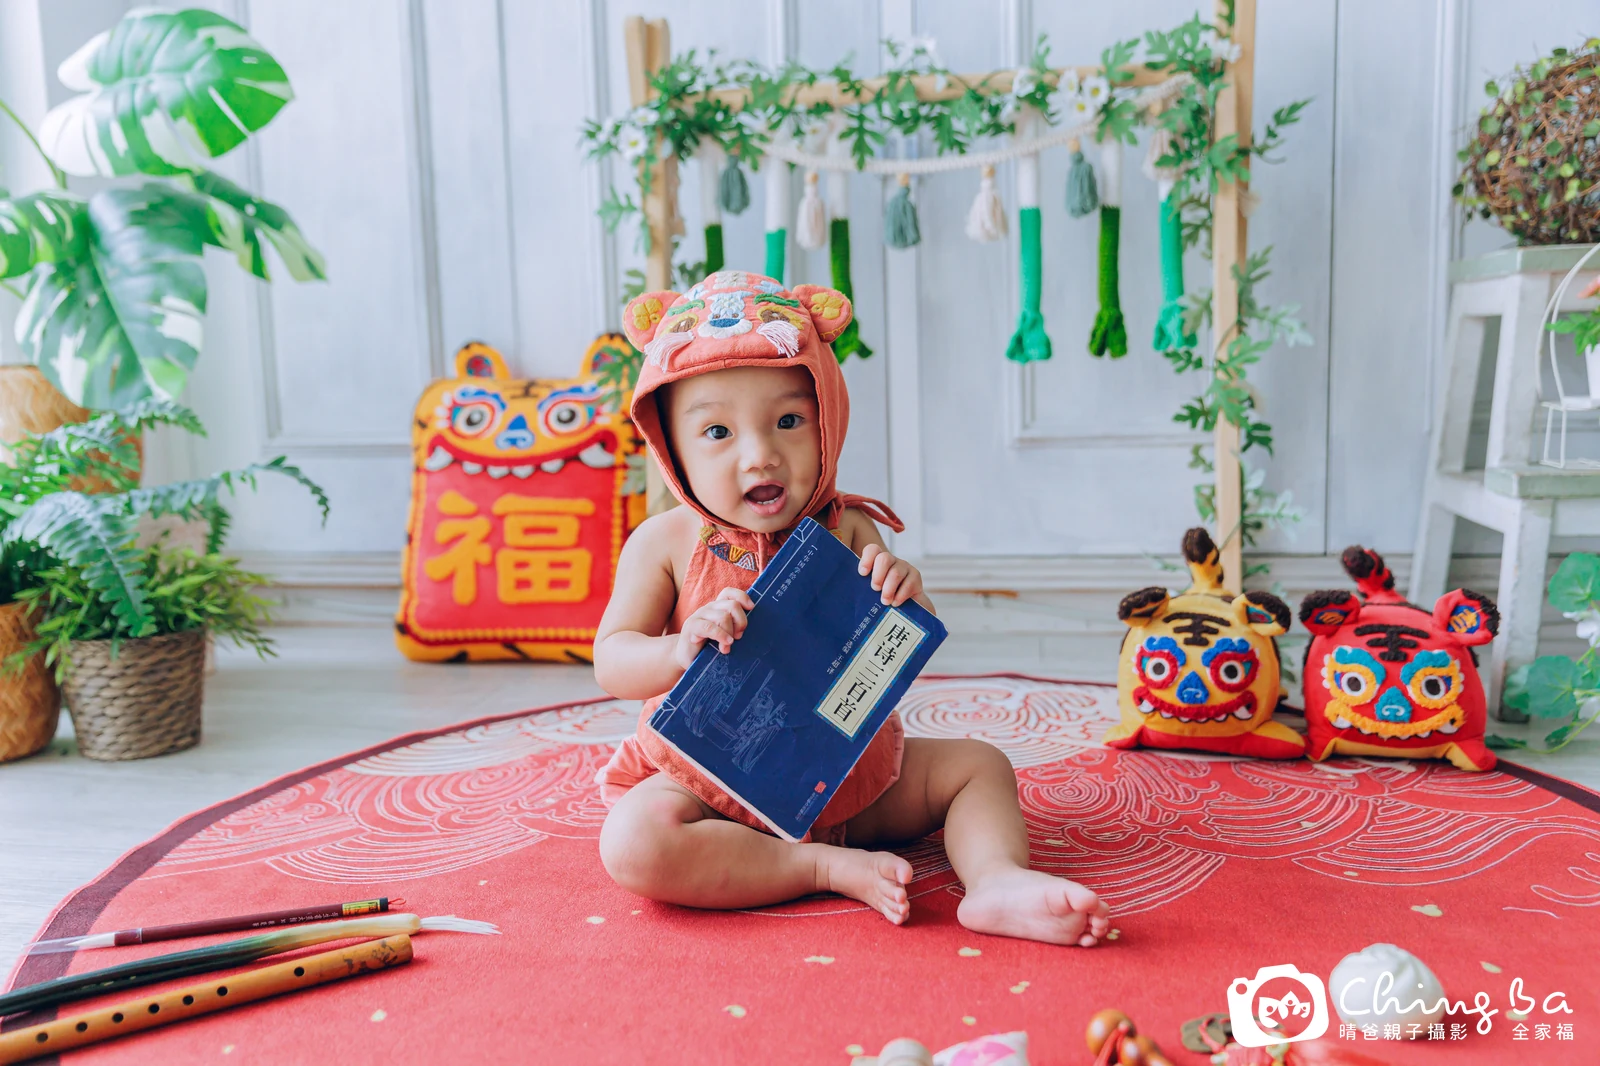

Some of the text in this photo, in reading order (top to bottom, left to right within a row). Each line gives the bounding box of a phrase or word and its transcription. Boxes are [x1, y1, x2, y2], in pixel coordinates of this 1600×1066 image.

[424, 490, 595, 605] 福
[832, 623, 911, 723] 唐诗三百首
